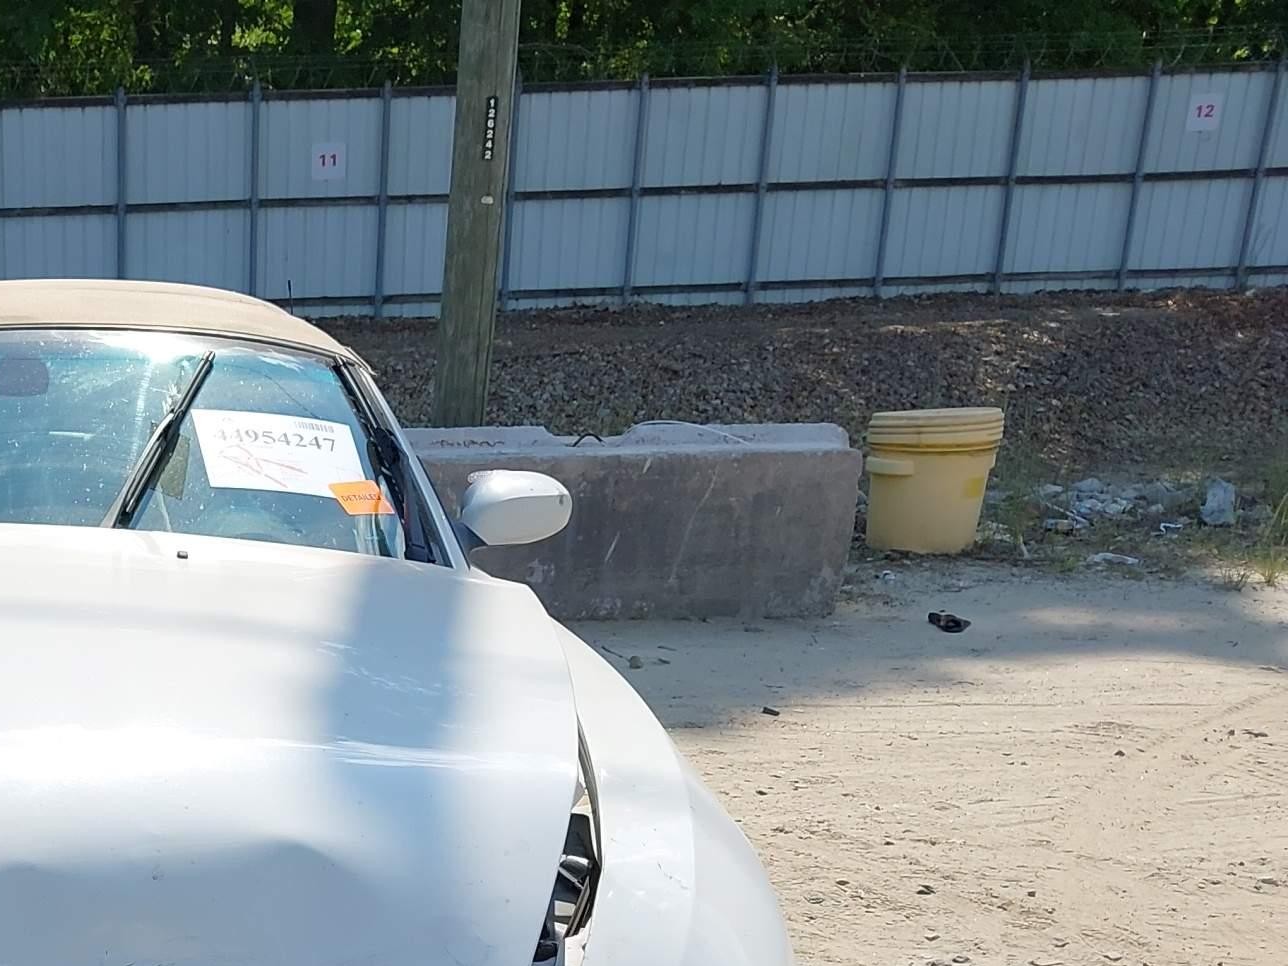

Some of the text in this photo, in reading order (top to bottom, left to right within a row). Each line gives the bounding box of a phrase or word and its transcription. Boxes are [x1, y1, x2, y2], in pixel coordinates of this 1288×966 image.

[1196, 104, 1215, 118] 12
[319, 153, 337, 167] 11
[213, 428, 336, 452] 44954247
